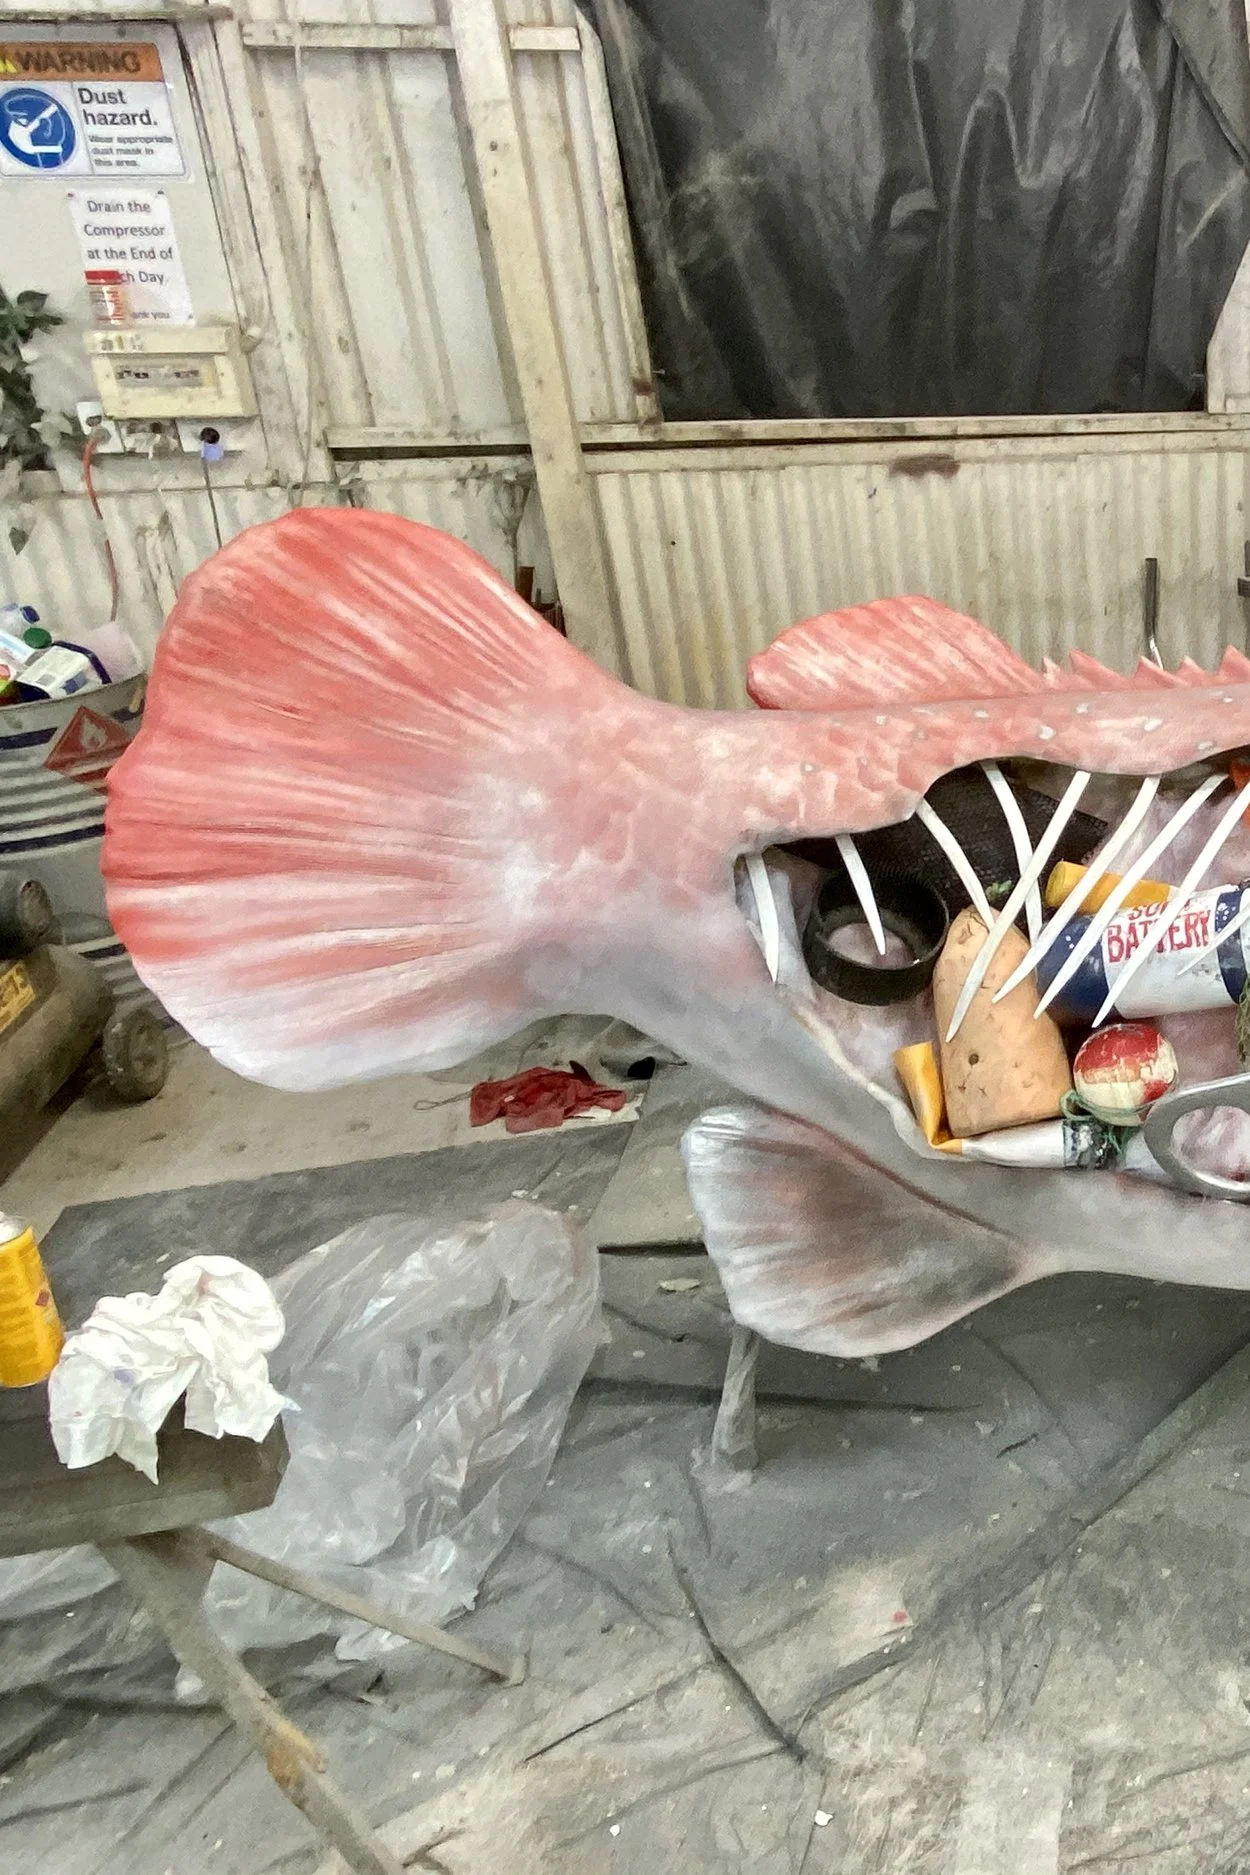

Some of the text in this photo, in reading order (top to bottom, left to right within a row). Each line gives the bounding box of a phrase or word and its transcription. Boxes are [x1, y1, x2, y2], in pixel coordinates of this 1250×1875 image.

[20, 50, 141, 73] WARNING
[78, 88, 127, 105] Dust
[83, 109, 158, 126] hazard.
[87, 200, 151, 213] Drain the
[84, 224, 165, 239] Compressor
[87, 246, 173, 260] at the End of
[138, 271, 164, 286] Day
